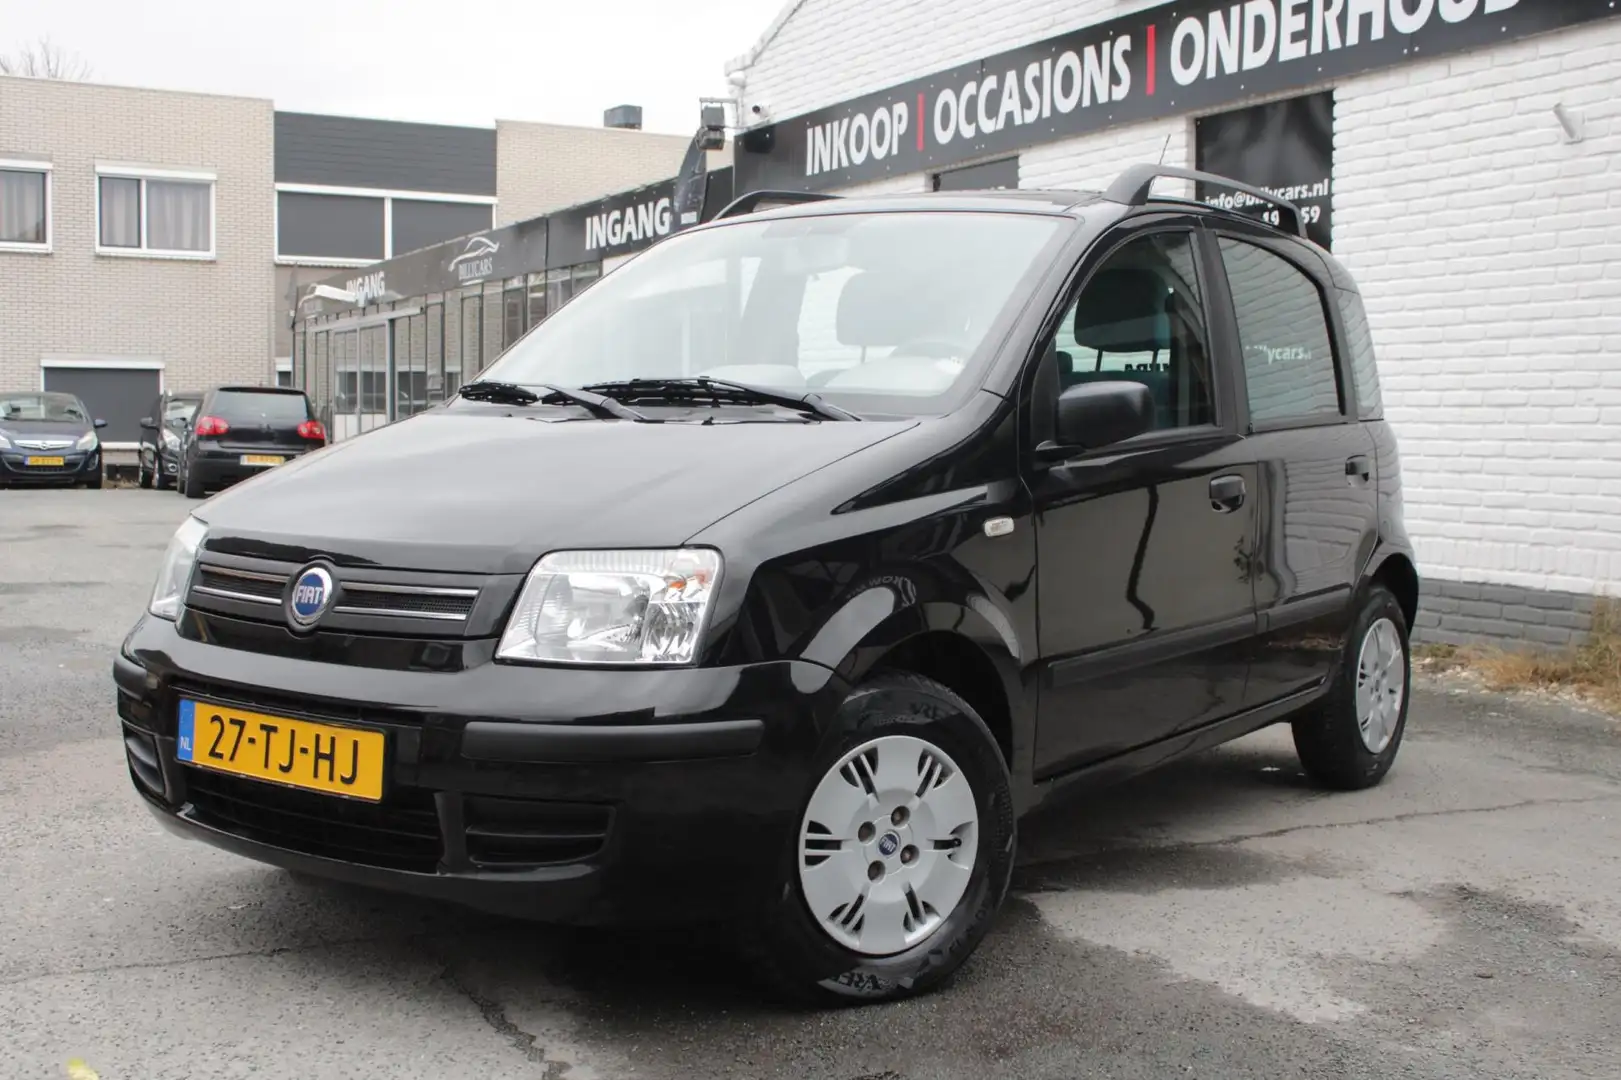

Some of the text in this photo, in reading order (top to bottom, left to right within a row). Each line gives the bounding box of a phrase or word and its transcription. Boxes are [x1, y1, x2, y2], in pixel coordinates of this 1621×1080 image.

[806, 0, 1520, 176] INKOOP OCCASIONS ONDERH
[585, 197, 671, 250] INGANG
[296, 585, 324, 604] FIAT
[180, 736, 192, 751] NL
[208, 714, 359, 785] 27-TJ-HJ
